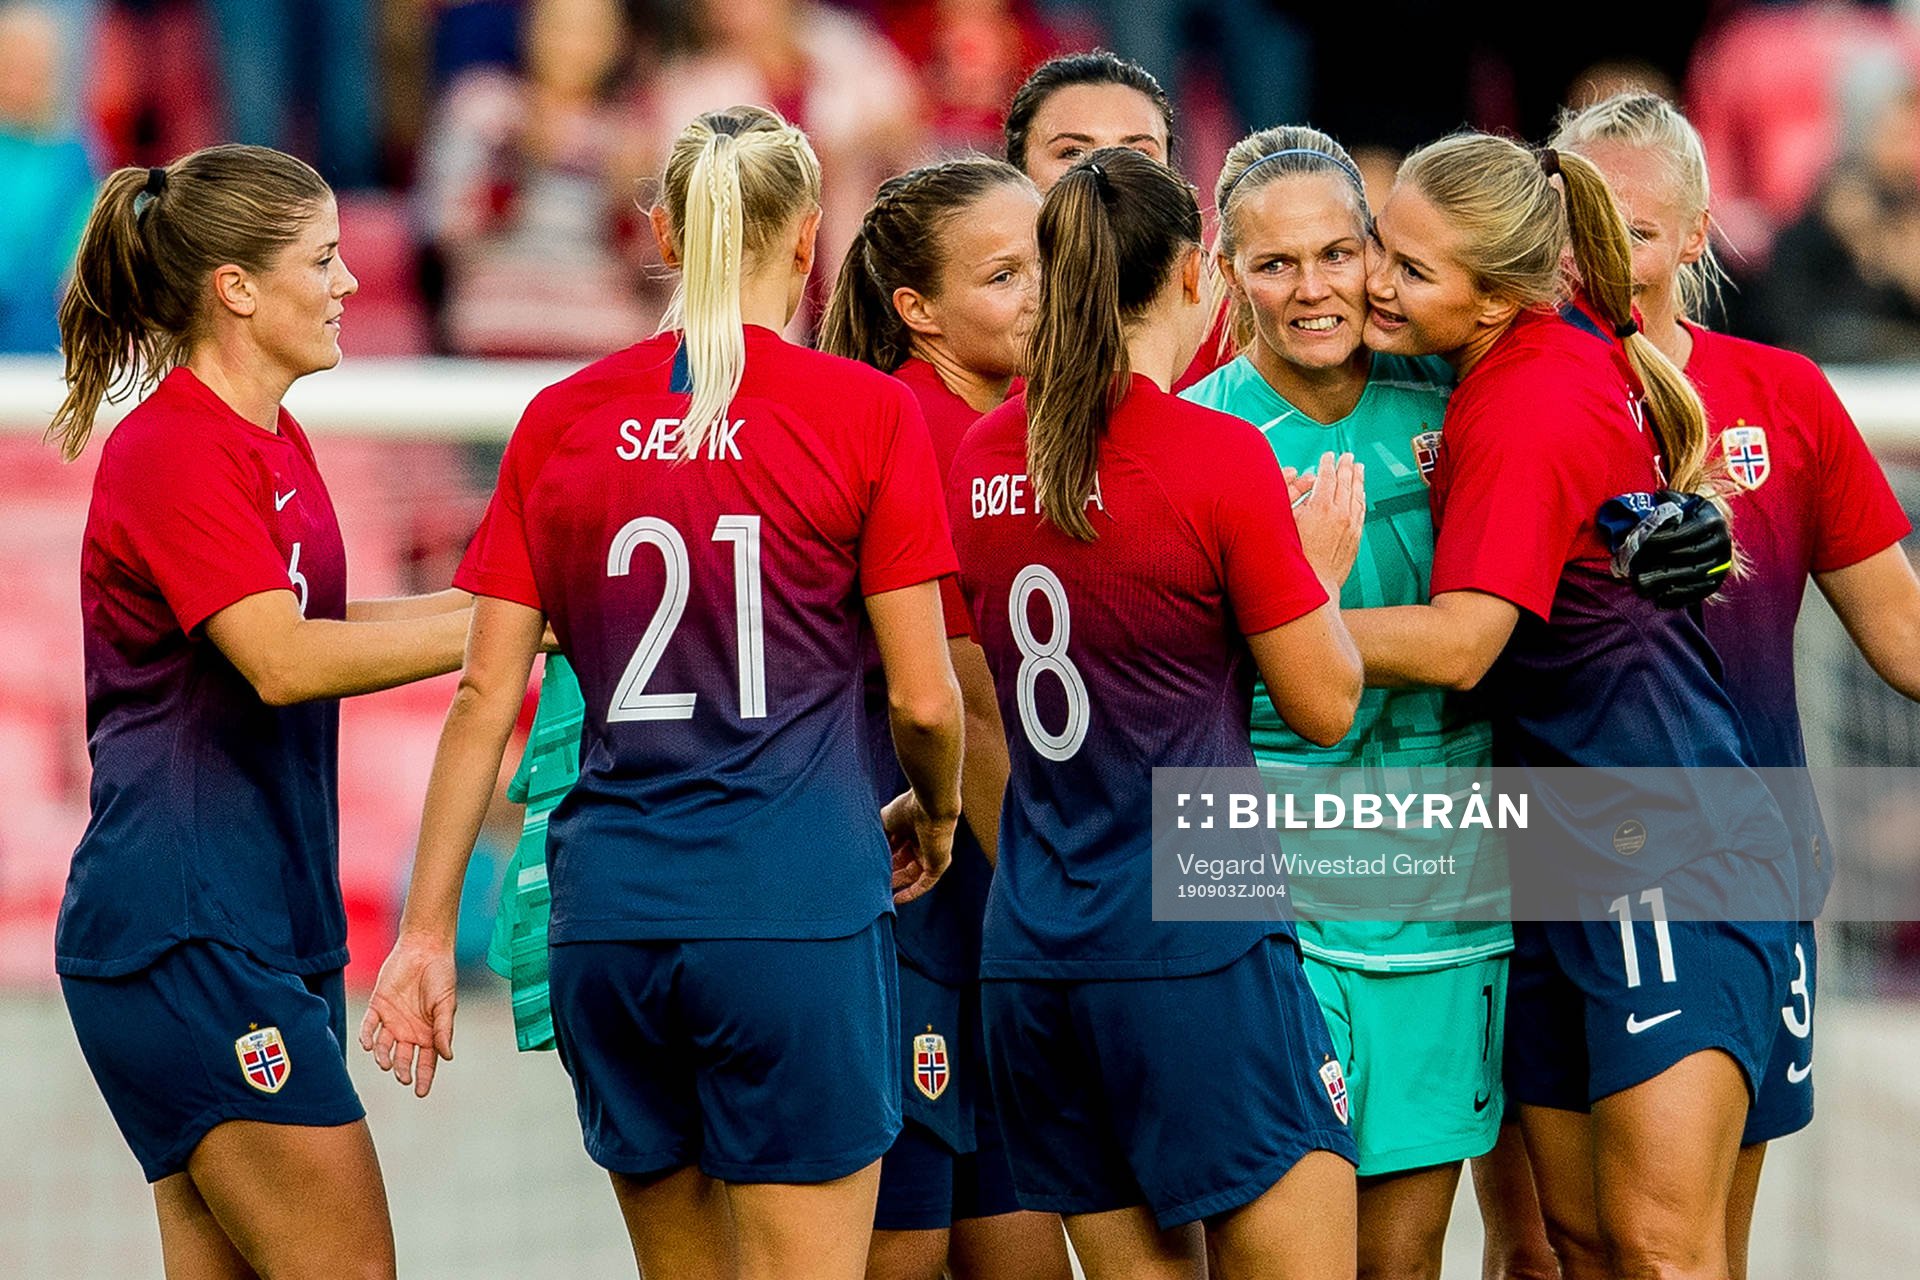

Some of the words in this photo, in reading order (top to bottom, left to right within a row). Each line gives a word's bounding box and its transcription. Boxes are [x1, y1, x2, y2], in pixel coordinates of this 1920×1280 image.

[606, 515, 767, 723] 21
[1008, 564, 1090, 762] 8
[1608, 887, 1677, 988] 11
[1482, 984, 1493, 1062] 1
[1781, 942, 1811, 1038] 3
